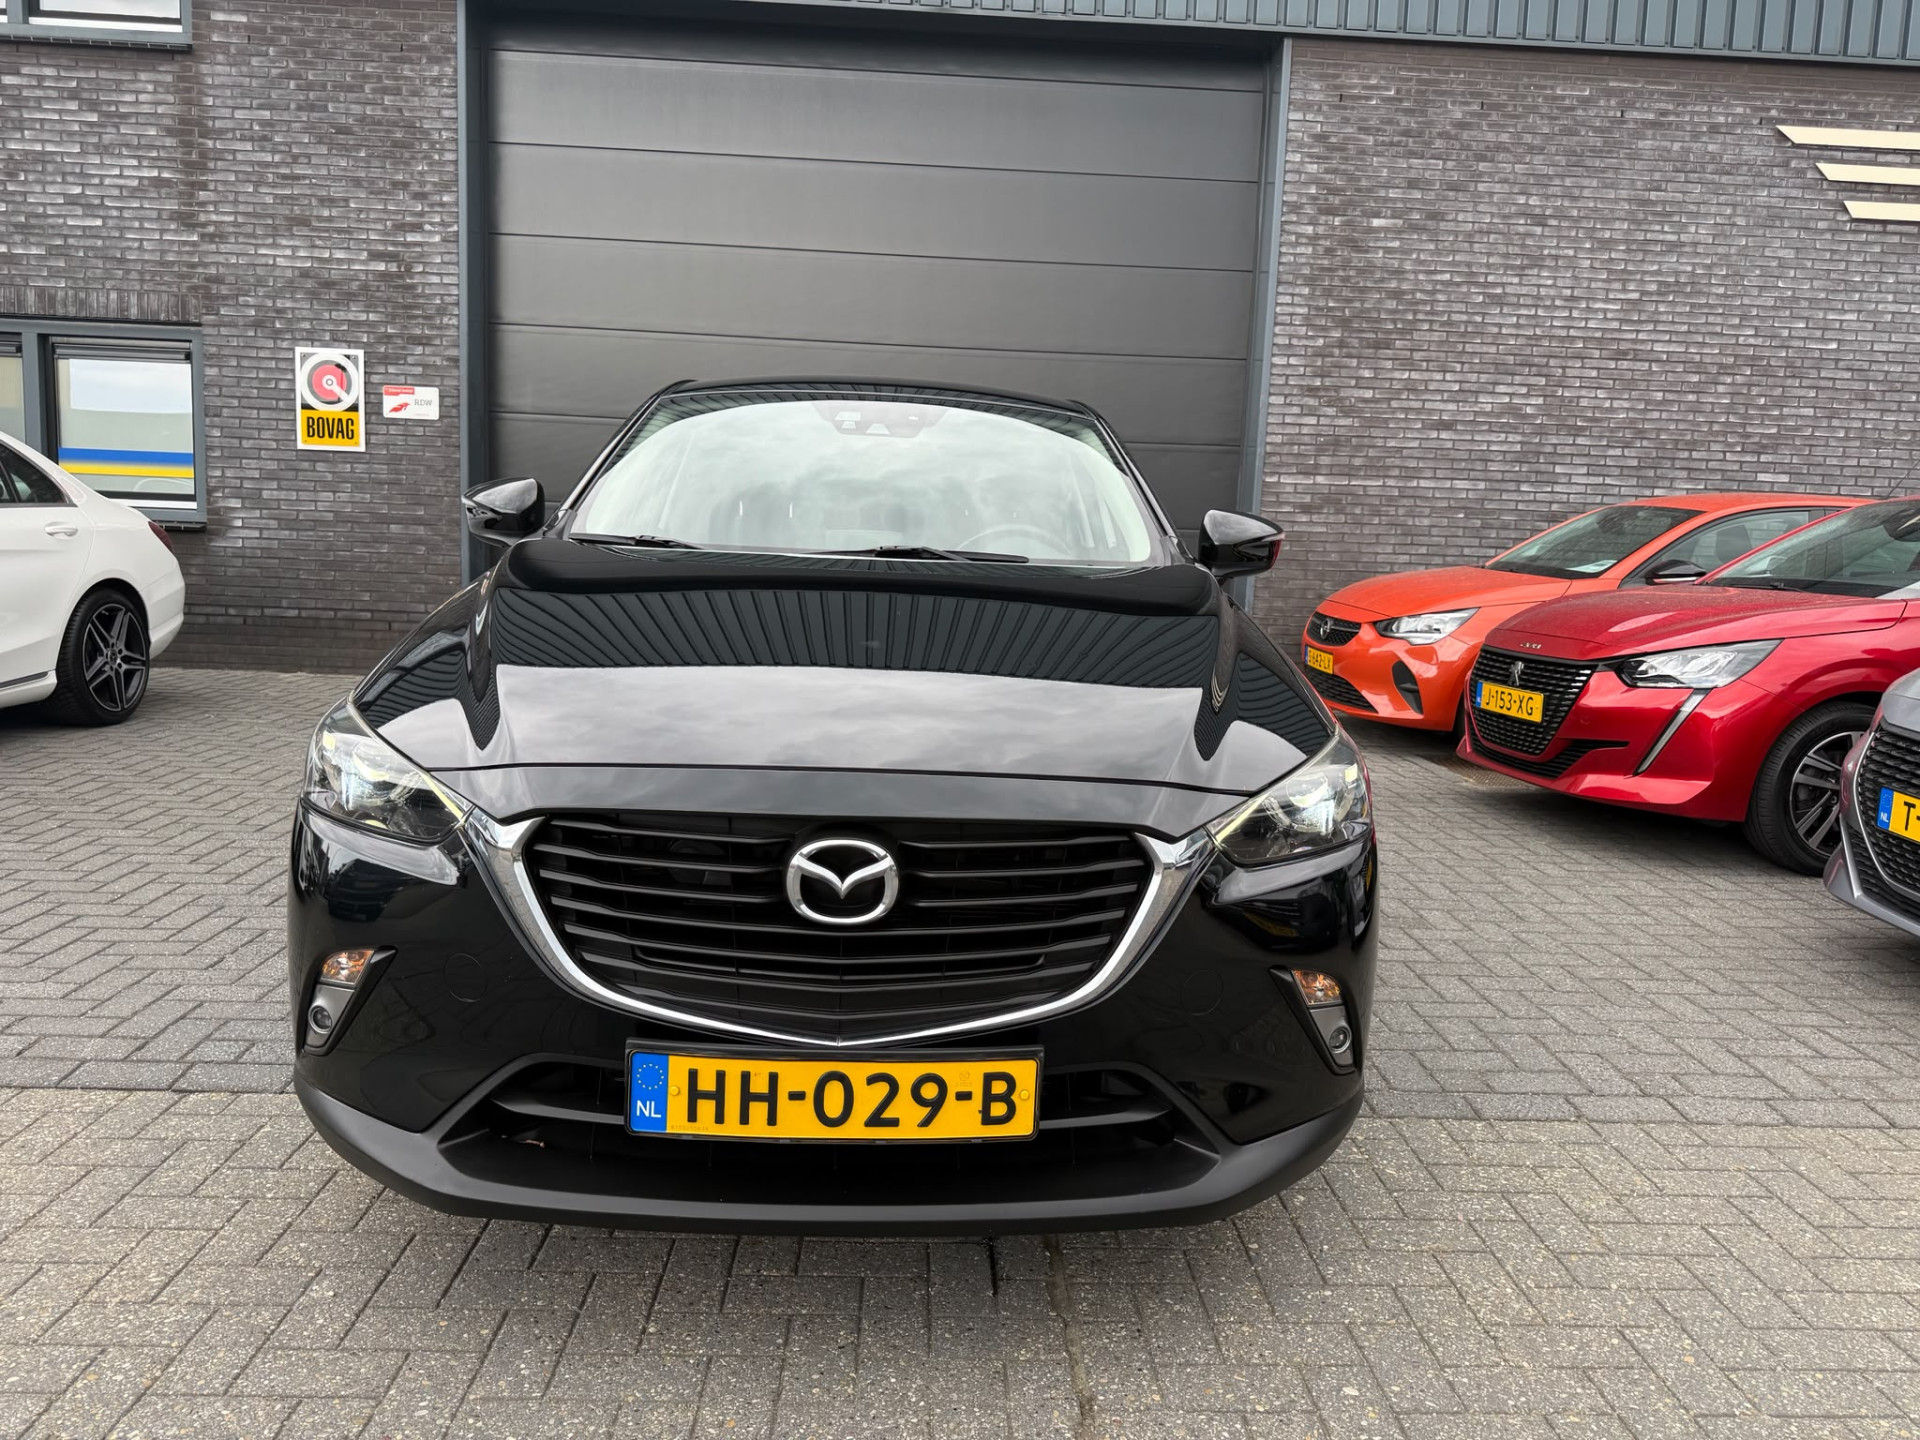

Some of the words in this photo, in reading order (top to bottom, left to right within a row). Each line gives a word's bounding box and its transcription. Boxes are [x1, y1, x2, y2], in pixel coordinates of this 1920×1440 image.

[306, 416, 354, 440] BOVAG
[1485, 688, 1534, 716] J-153-XG
[1880, 811, 1890, 823] NL
[636, 1100, 661, 1118] NL
[687, 1068, 1017, 1128] HH-029-B
